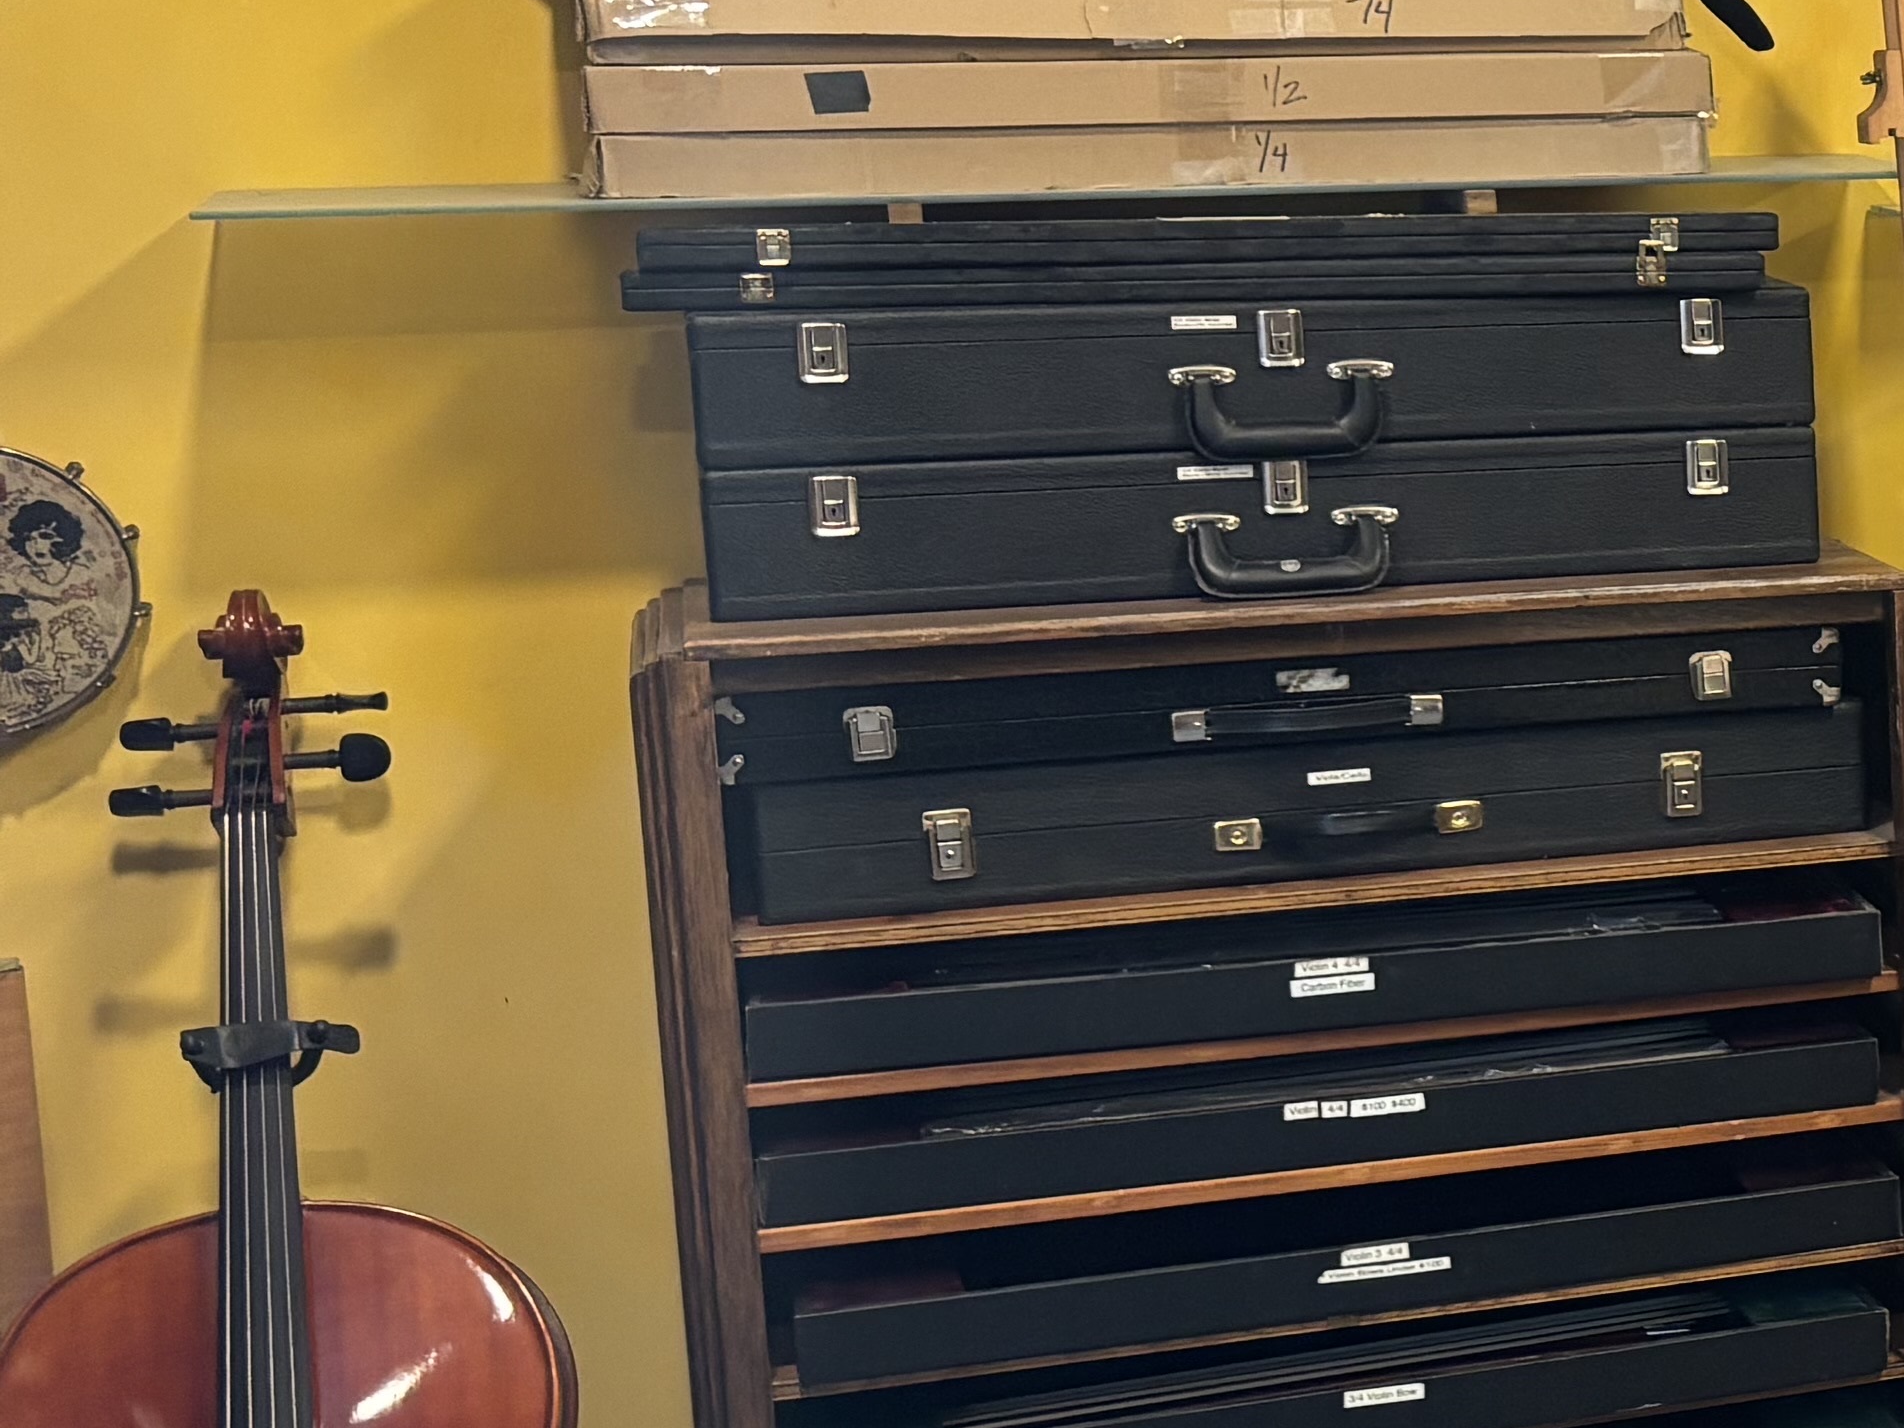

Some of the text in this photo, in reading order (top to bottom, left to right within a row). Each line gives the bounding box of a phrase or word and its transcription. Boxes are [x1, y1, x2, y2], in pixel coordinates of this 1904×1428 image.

[1263, 65, 1308, 107] 1/2
[1254, 130, 1288, 173] 1/4
[1301, 978, 1366, 993] Carbon Fiber
